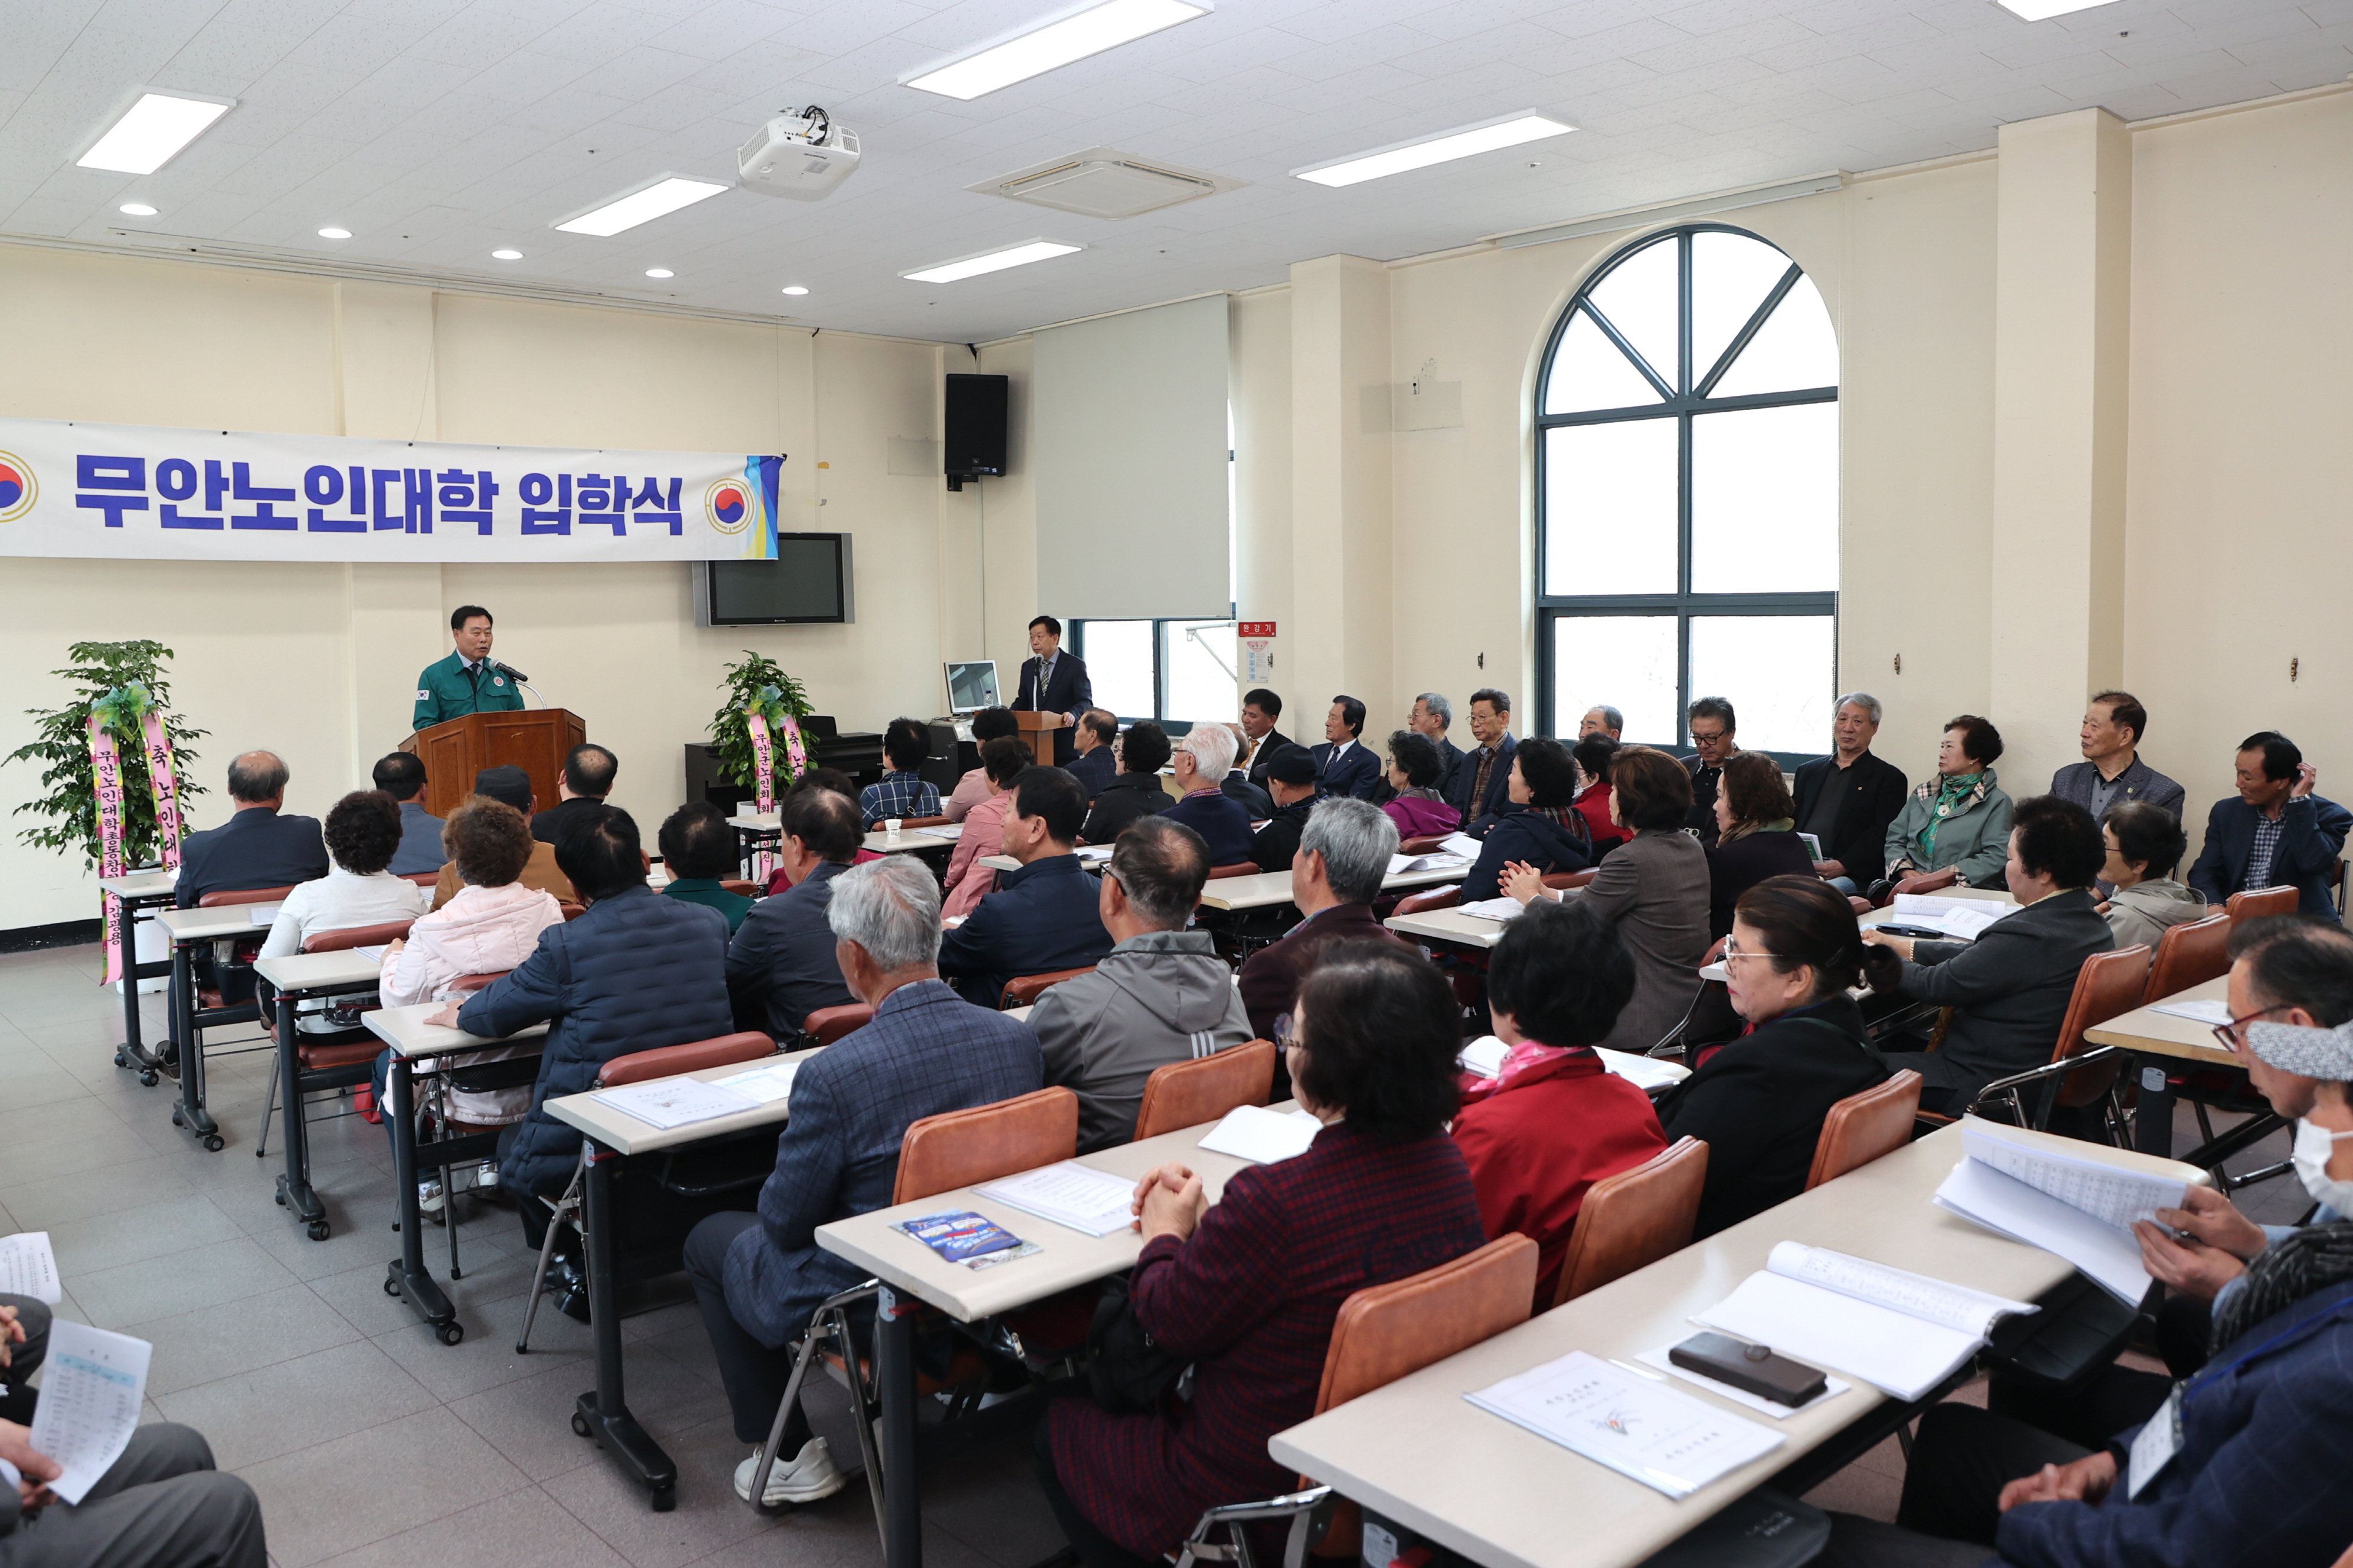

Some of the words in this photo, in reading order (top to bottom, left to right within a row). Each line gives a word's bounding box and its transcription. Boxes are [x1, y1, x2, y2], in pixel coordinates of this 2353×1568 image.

[76, 455, 499, 535] 무안노인대학
[519, 472, 682, 536] 입학식
[152, 745, 168, 769] 축
[789, 731, 799, 748] 축
[755, 733, 771, 799] 무안군노인회
